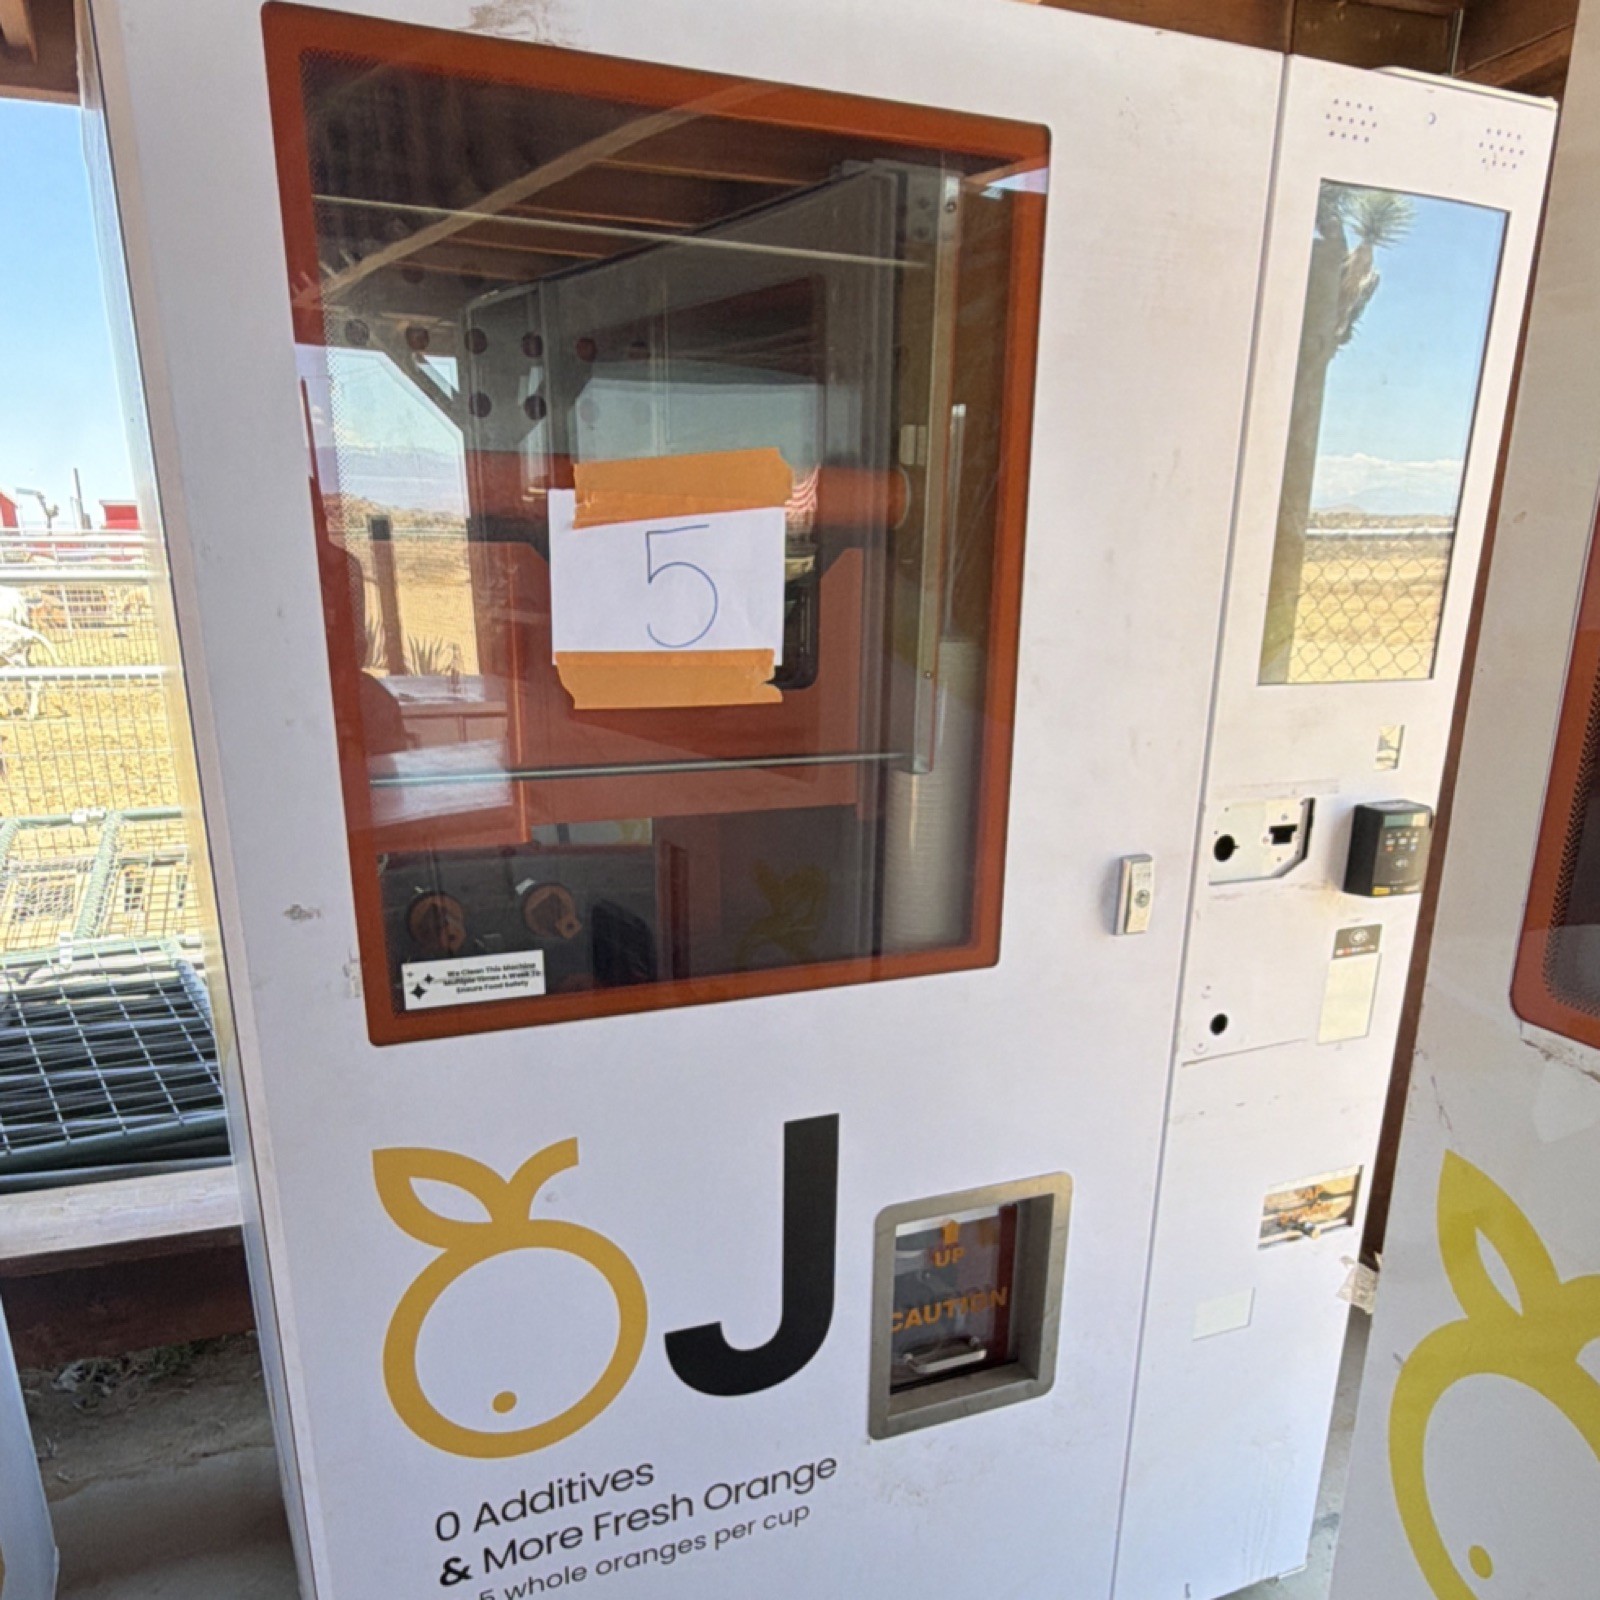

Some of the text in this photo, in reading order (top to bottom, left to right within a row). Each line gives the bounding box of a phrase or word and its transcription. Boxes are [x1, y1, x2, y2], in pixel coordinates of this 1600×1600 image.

[645, 524, 718, 648] 5
[456, 979, 529, 994] Ensure Food Safety
[461, 967, 484, 976] Clean
[486, 965, 501, 974] This
[503, 962, 536, 972] Machine
[509, 970, 530, 979] Week
[934, 1247, 966, 1268] UP
[891, 1286, 1008, 1333] CAUTION
[473, 1462, 654, 1533] Additives
[439, 1457, 837, 1587] & More Fresh Orange
[504, 1566, 587, 1600] whole
[595, 1534, 707, 1575] oranges
[714, 1519, 756, 1550] per
[763, 1505, 810, 1527] cup
